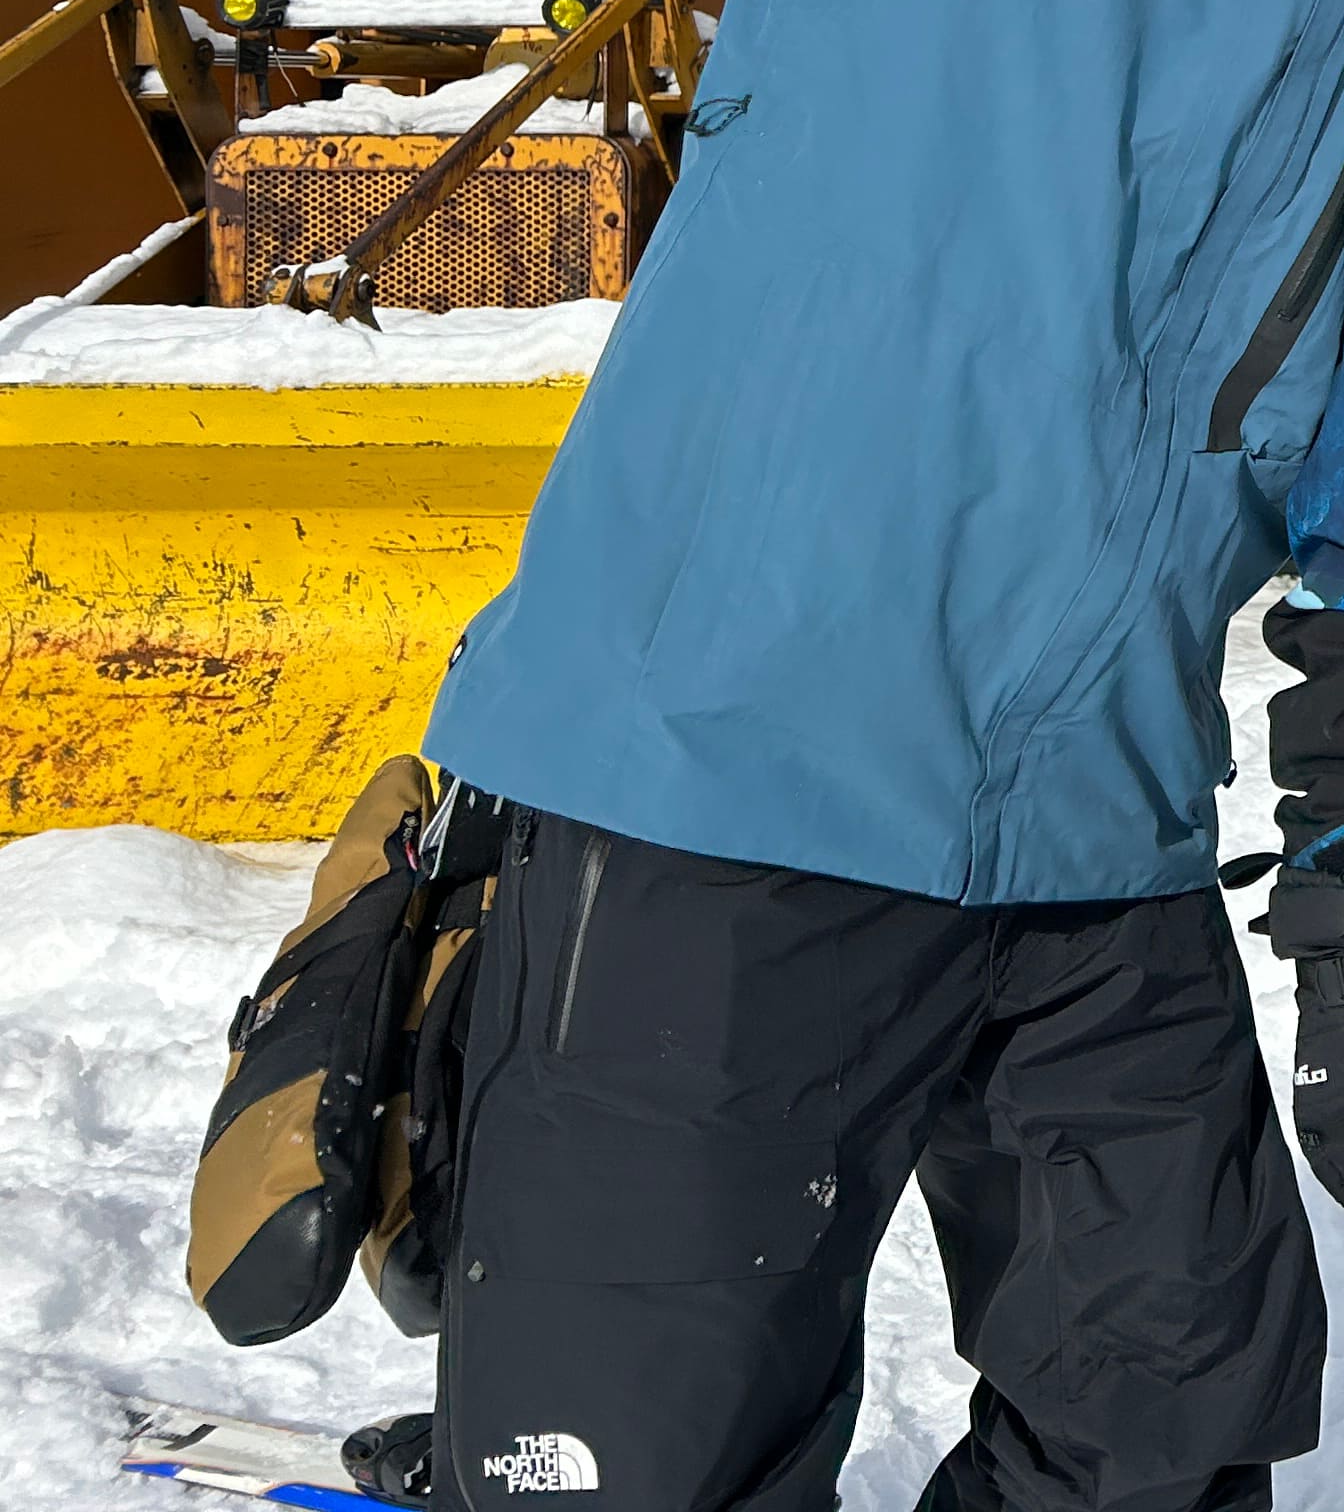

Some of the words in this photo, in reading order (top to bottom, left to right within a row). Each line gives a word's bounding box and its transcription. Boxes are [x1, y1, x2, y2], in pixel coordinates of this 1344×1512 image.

[514, 1433, 558, 1455] THE
[483, 1452, 558, 1477] NORTH
[508, 1470, 560, 1494] FACE
